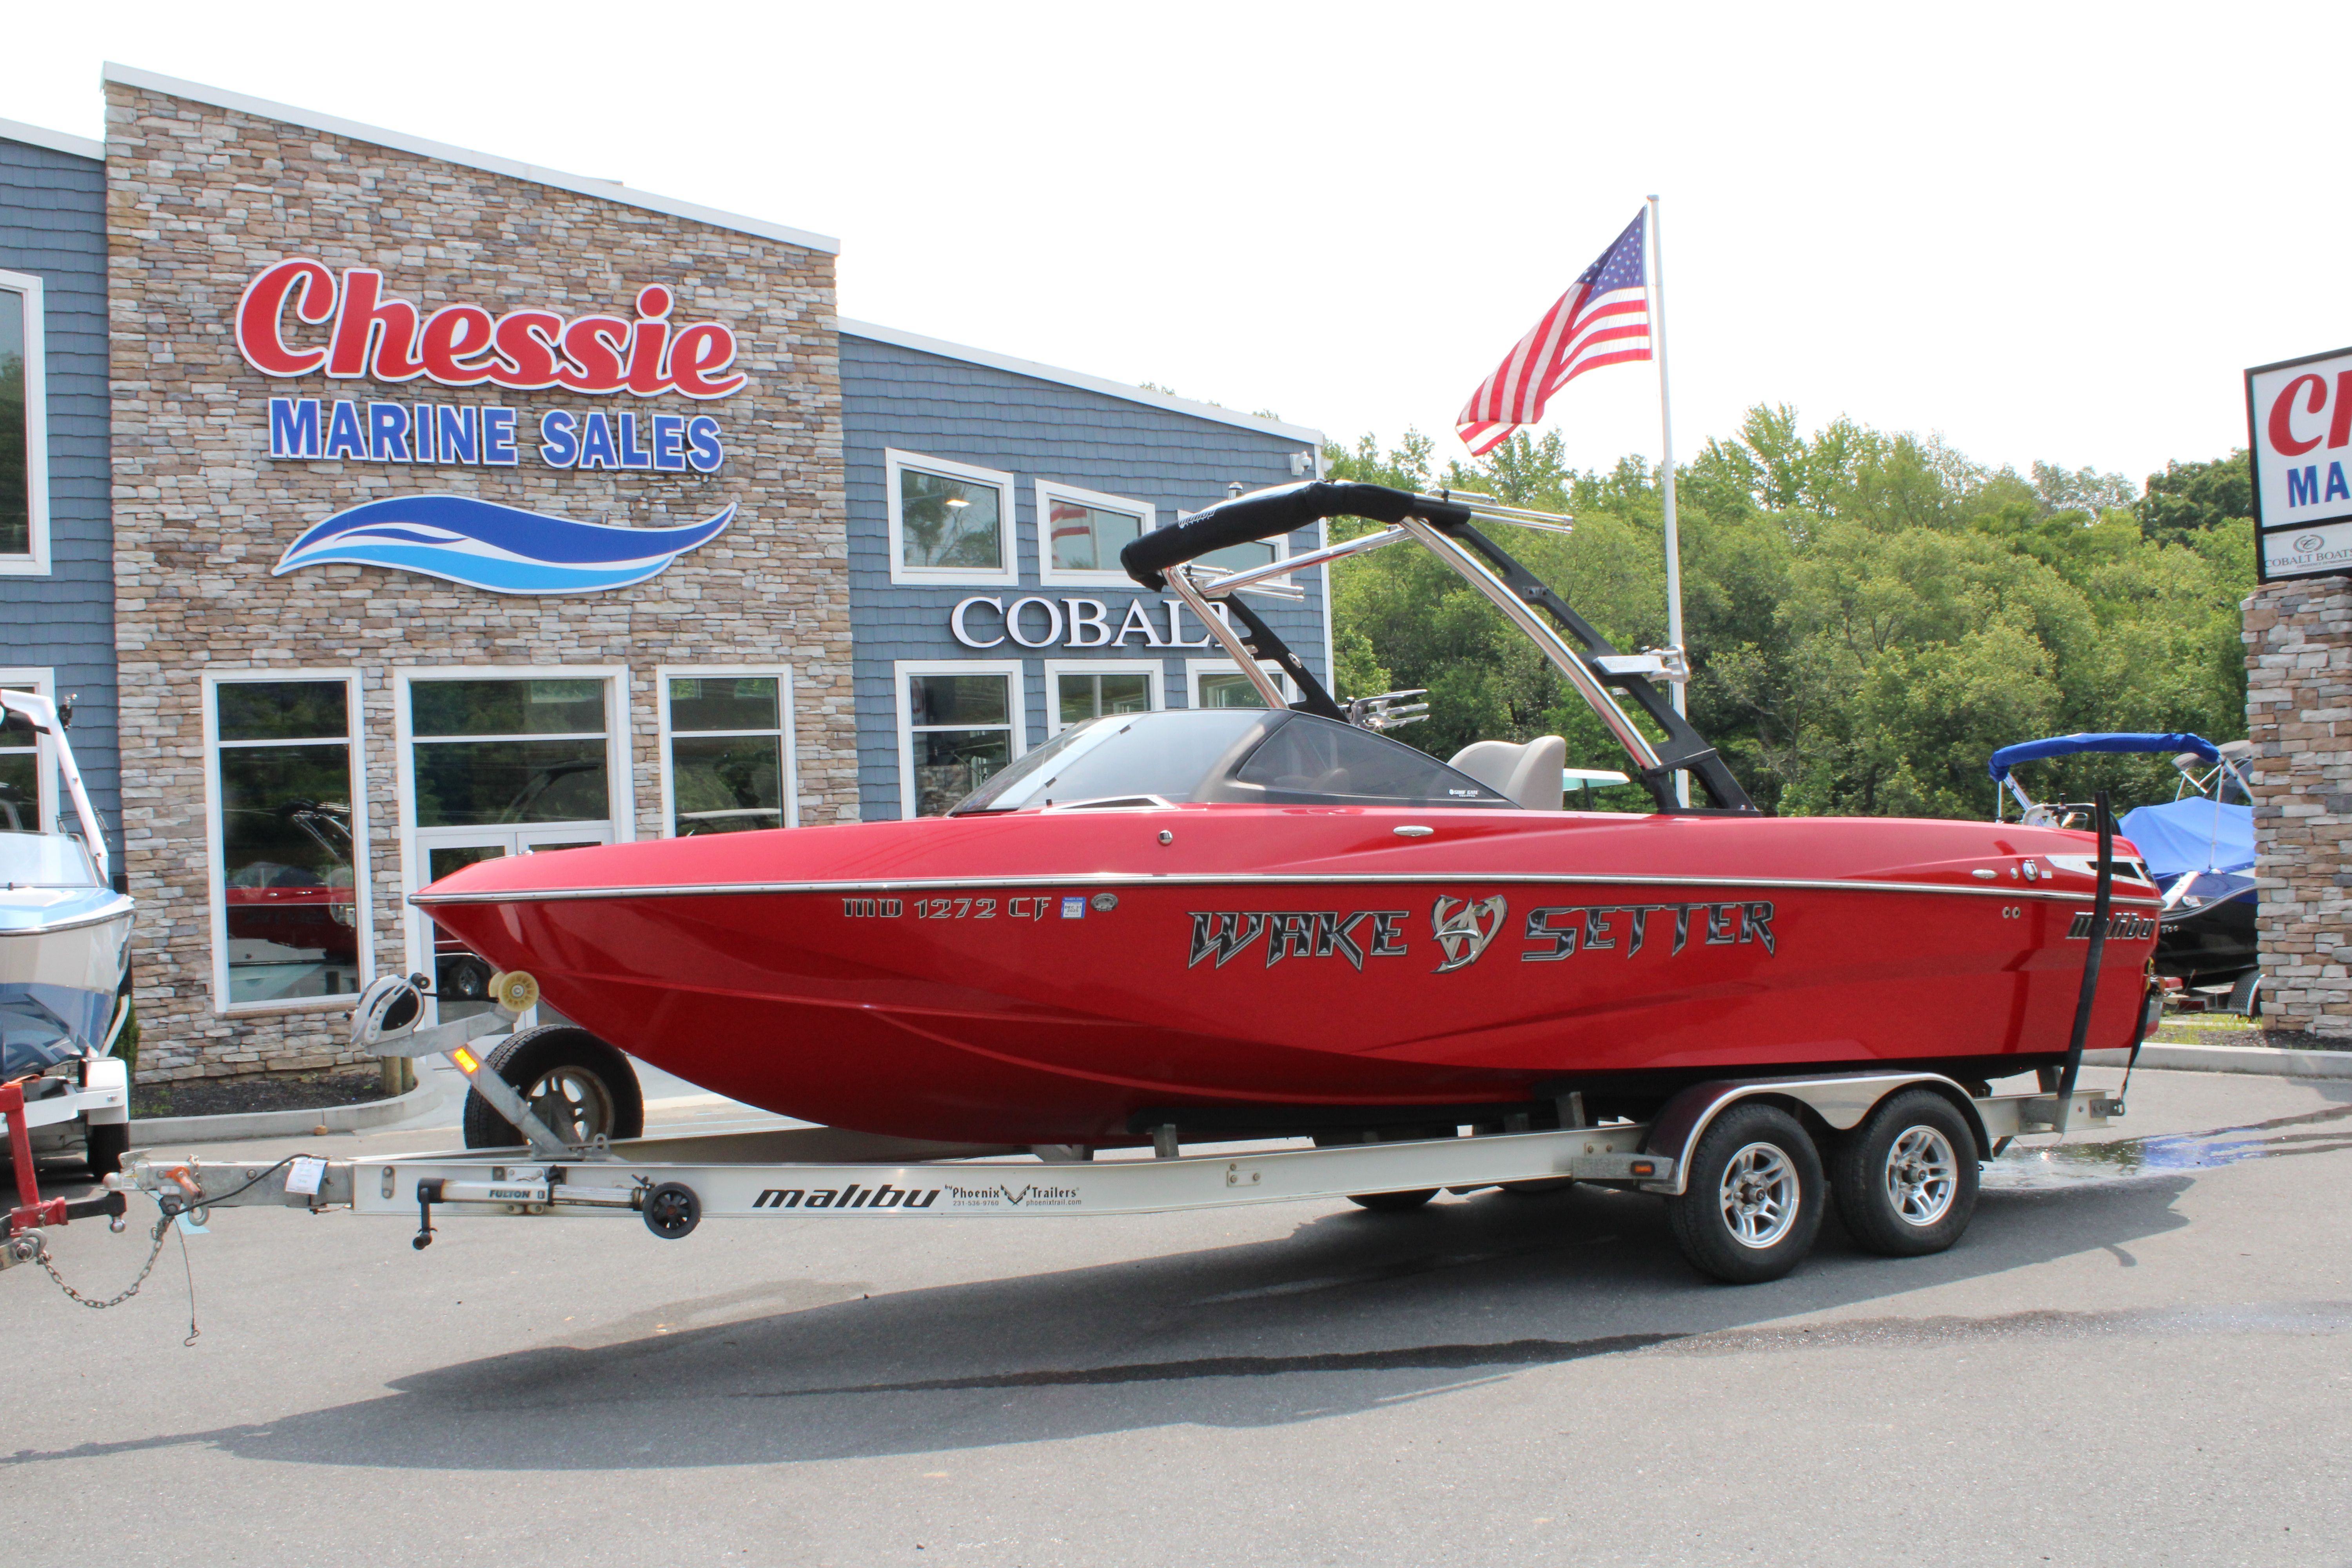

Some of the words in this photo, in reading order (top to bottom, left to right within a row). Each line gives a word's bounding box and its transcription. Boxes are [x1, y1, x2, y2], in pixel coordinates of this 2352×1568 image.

[236, 257, 748, 399] Chessie
[268, 397, 519, 466] MARINE
[540, 409, 724, 472] SALES
[2265, 554, 2312, 568] COBALT
[842, 898, 902, 917] MD
[914, 898, 996, 919] 1272
[1008, 897, 1052, 922] CF
[1187, 911, 1410, 973] WAKE
[1521, 900, 1775, 962] SETTER
[751, 1184, 941, 1208] malibu
[953, 1187, 1000, 1198] Phoenix
[1032, 1187, 1077, 1198] Trailers
